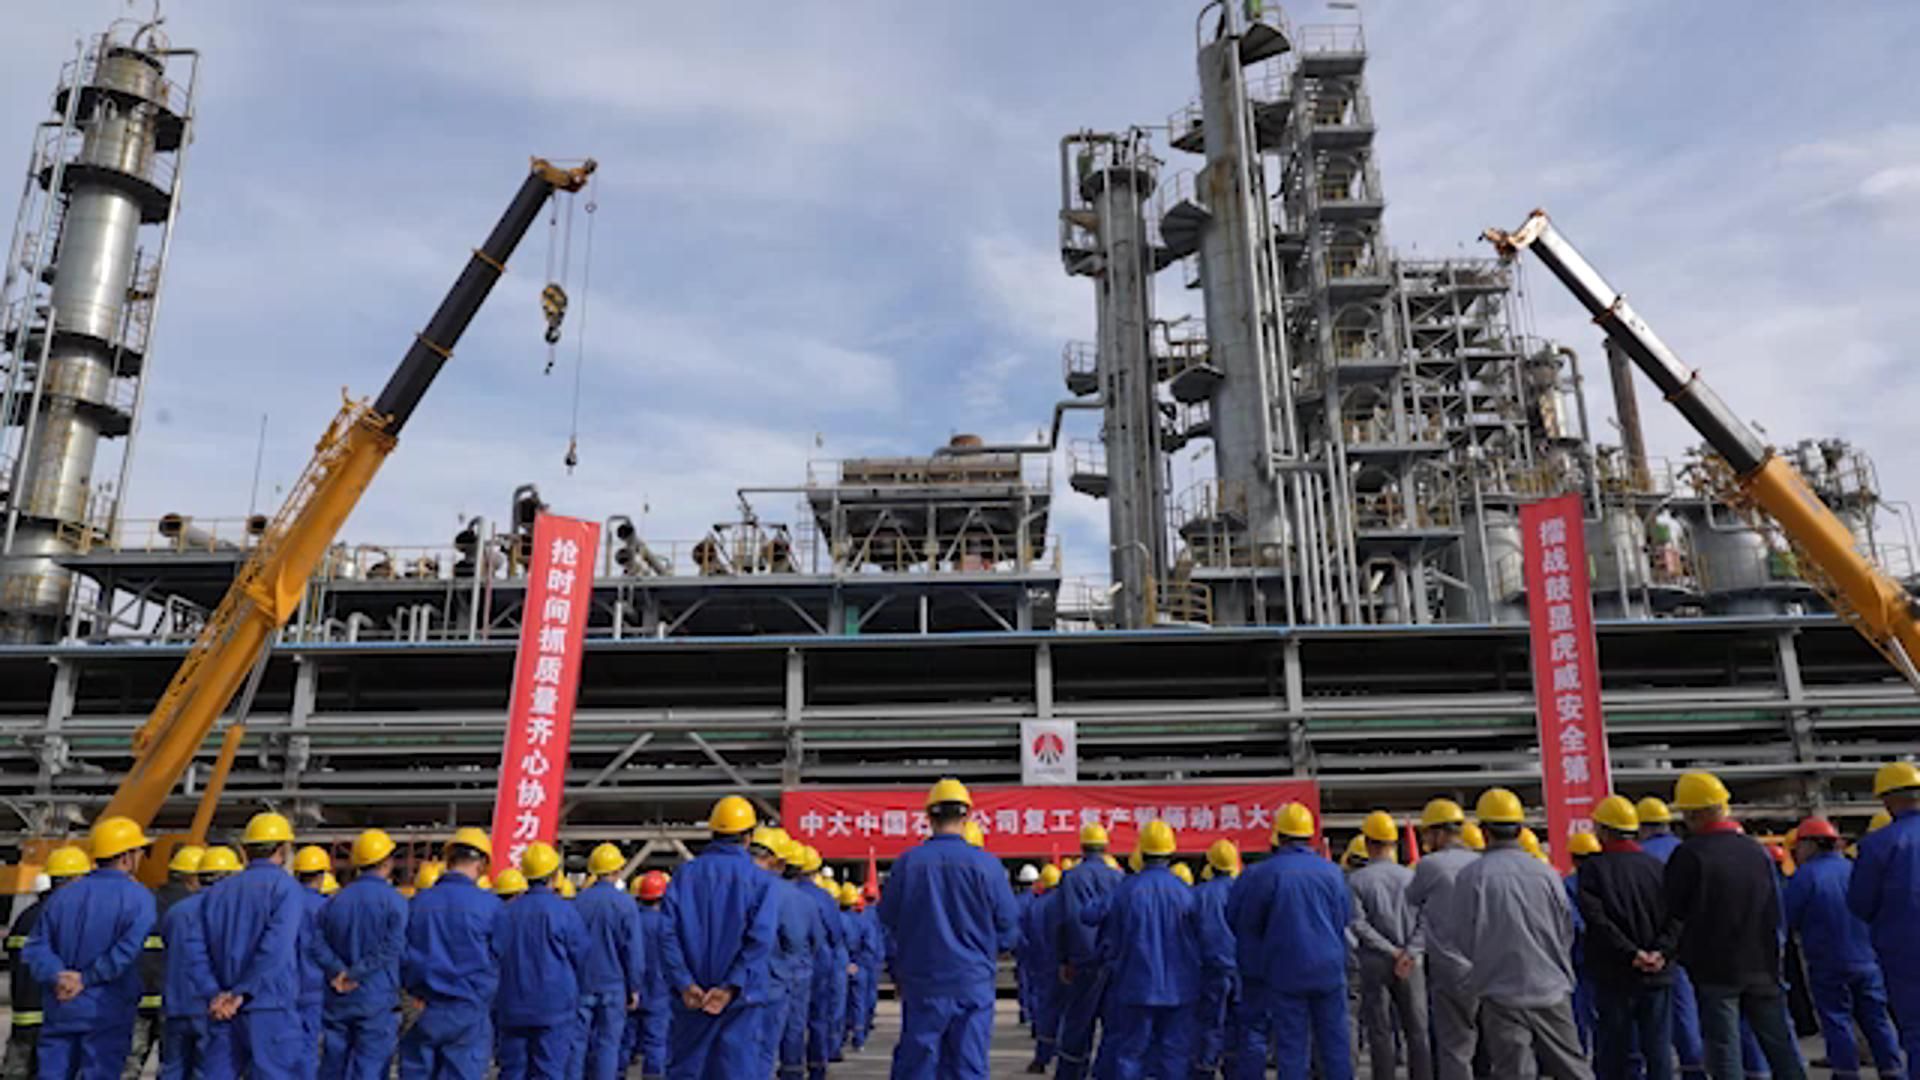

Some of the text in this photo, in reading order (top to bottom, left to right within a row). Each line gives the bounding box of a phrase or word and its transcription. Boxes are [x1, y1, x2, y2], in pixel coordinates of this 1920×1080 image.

[800, 804, 1286, 838] 中大中国石公司复工复产誓师动员大
